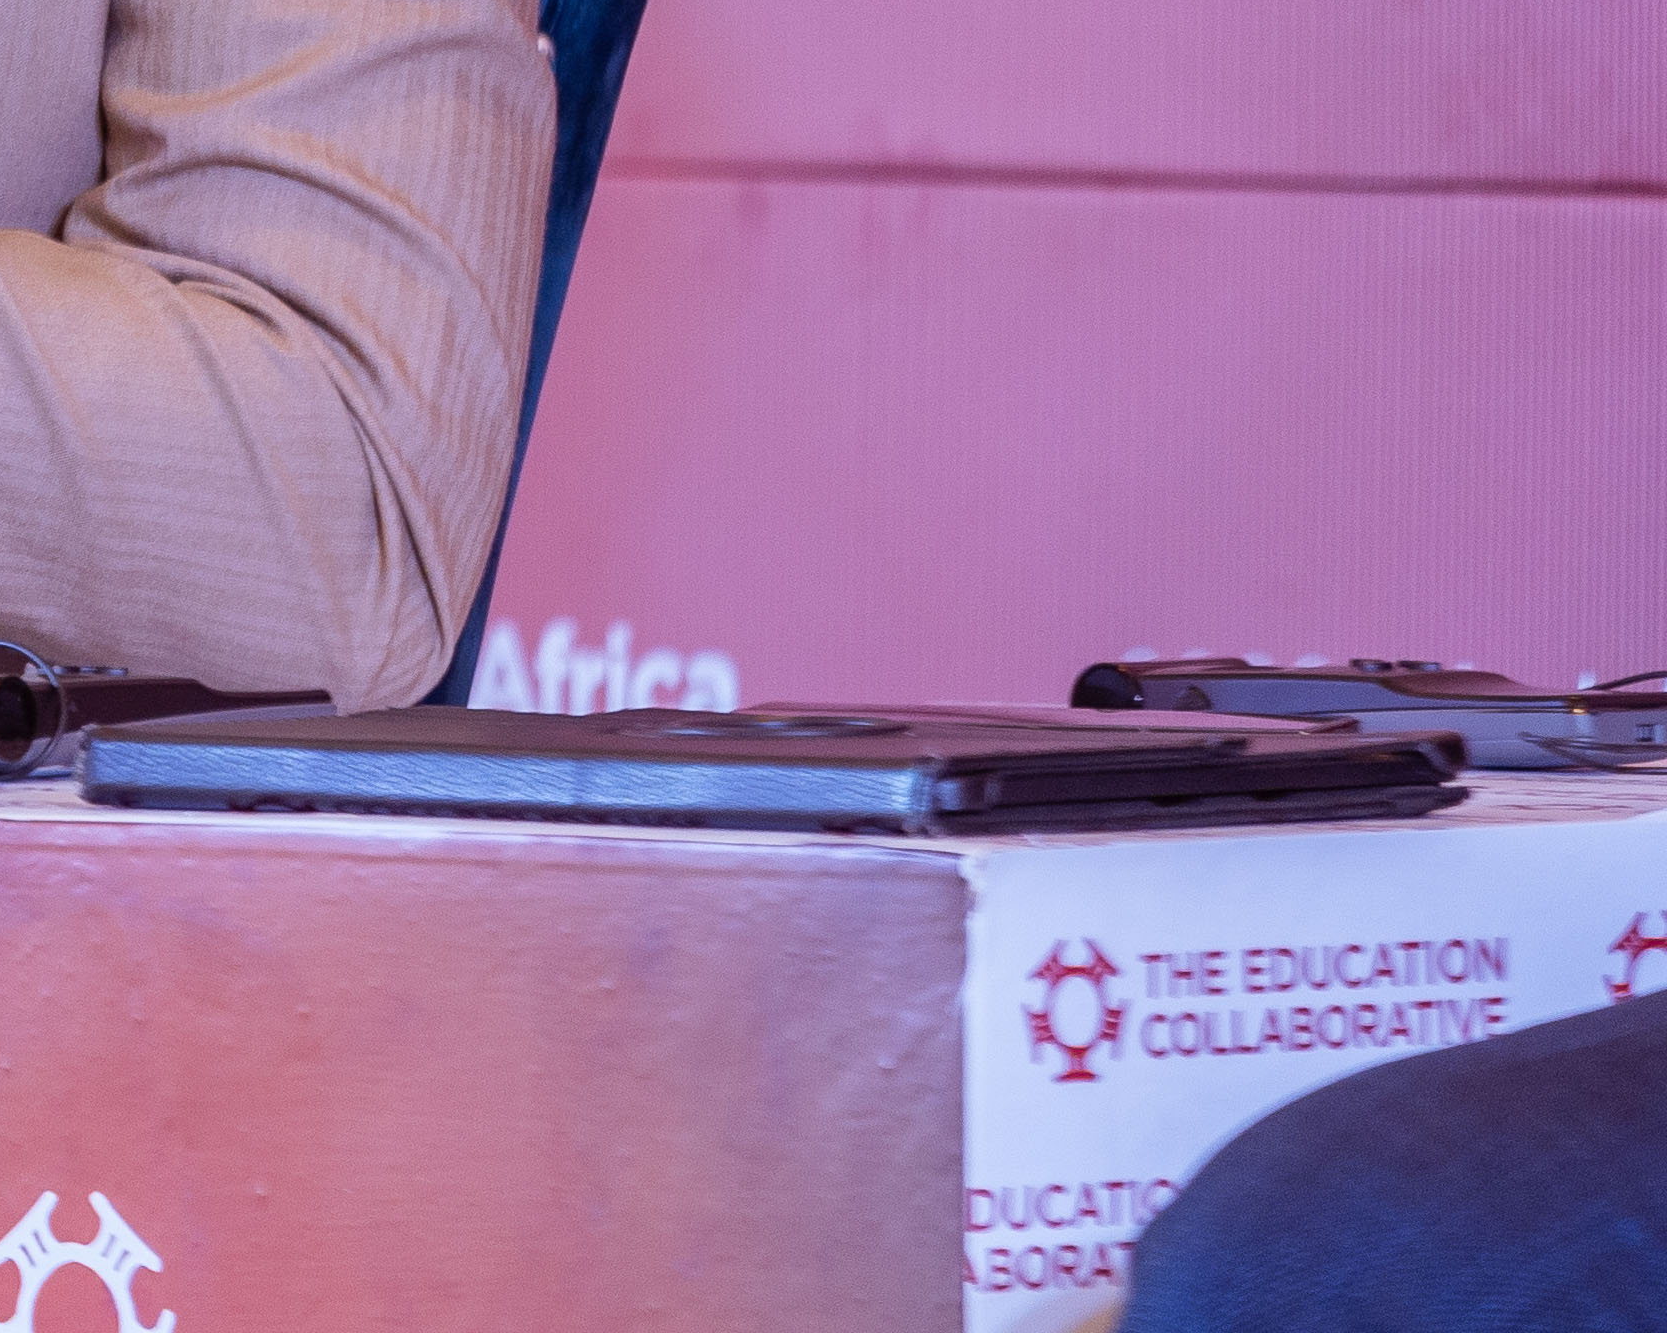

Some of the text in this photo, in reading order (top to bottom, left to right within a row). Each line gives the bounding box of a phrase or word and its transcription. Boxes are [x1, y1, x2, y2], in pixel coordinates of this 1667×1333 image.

[467, 615, 740, 716] Africa
[1138, 937, 1509, 999] THE EDUCATION
[1140, 997, 1505, 1059] COLLABORATIVE
